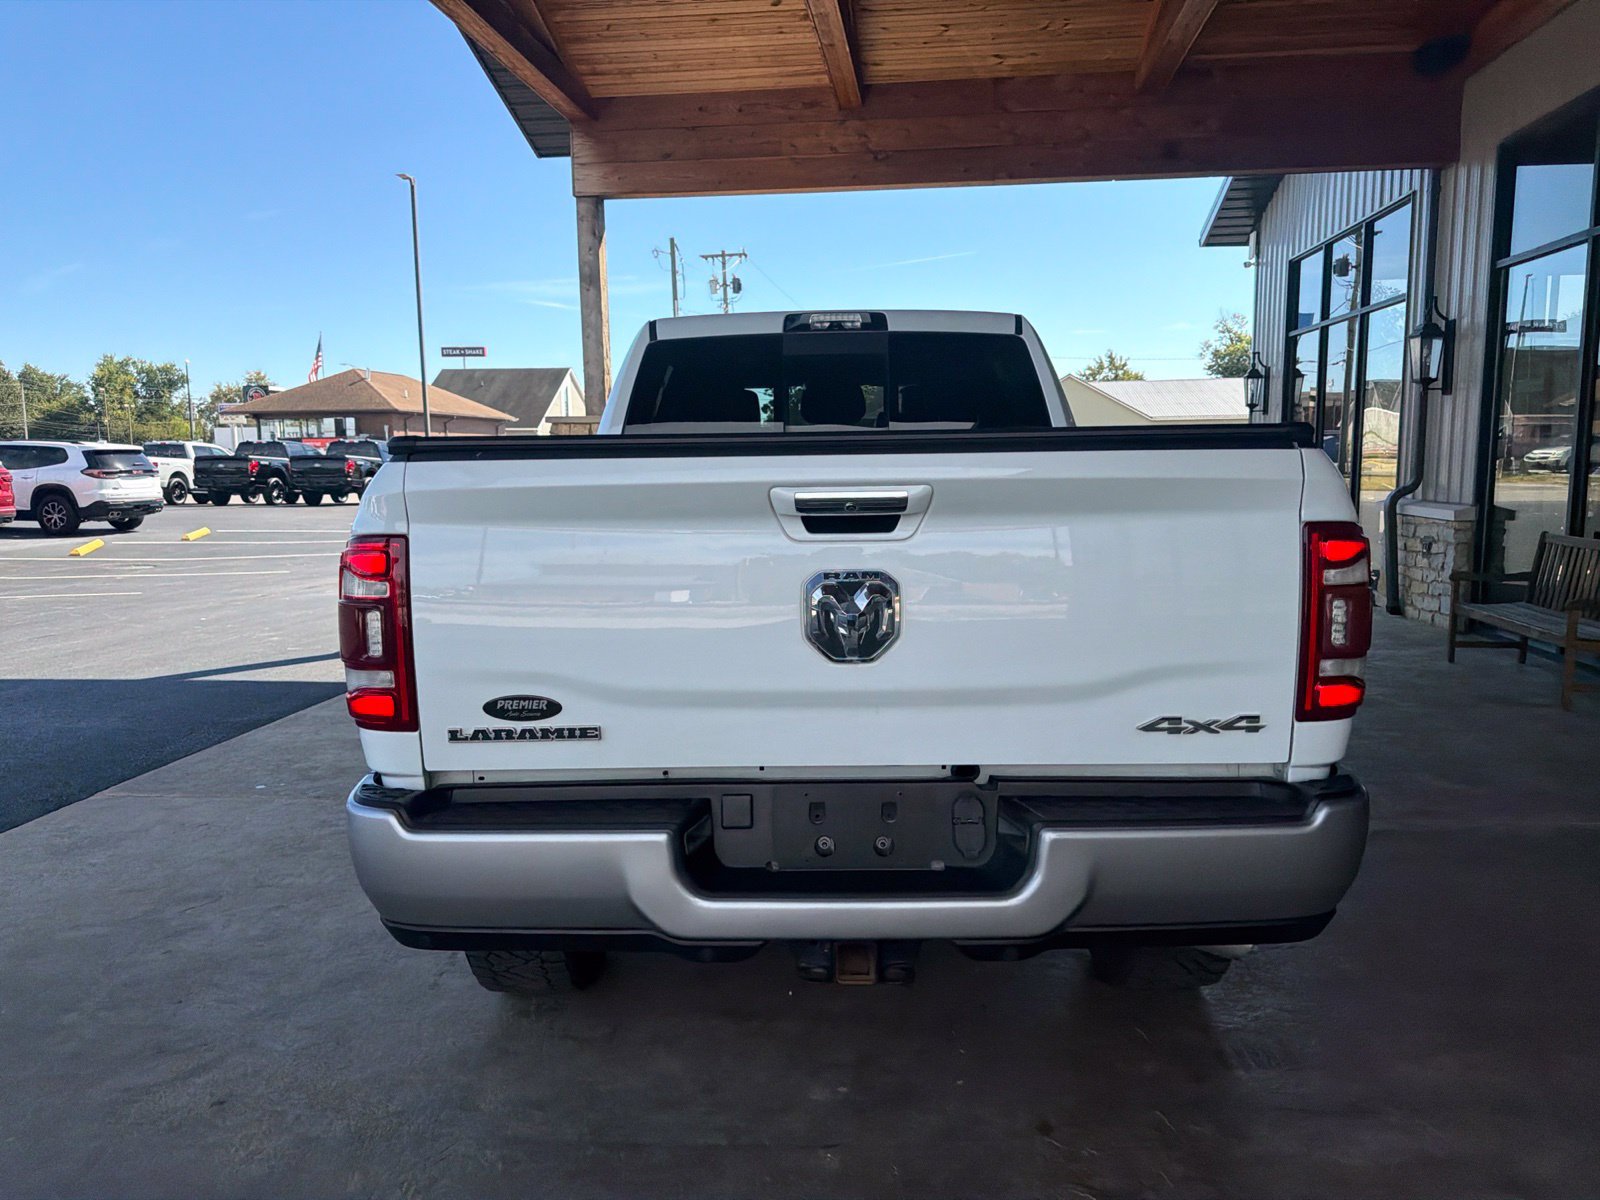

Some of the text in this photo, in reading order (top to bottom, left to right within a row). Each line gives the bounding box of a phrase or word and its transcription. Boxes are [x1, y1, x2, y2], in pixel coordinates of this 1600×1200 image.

[823, 572, 880, 580] RAM
[496, 700, 548, 710] PREMIER
[448, 727, 602, 743] LARAMIE
